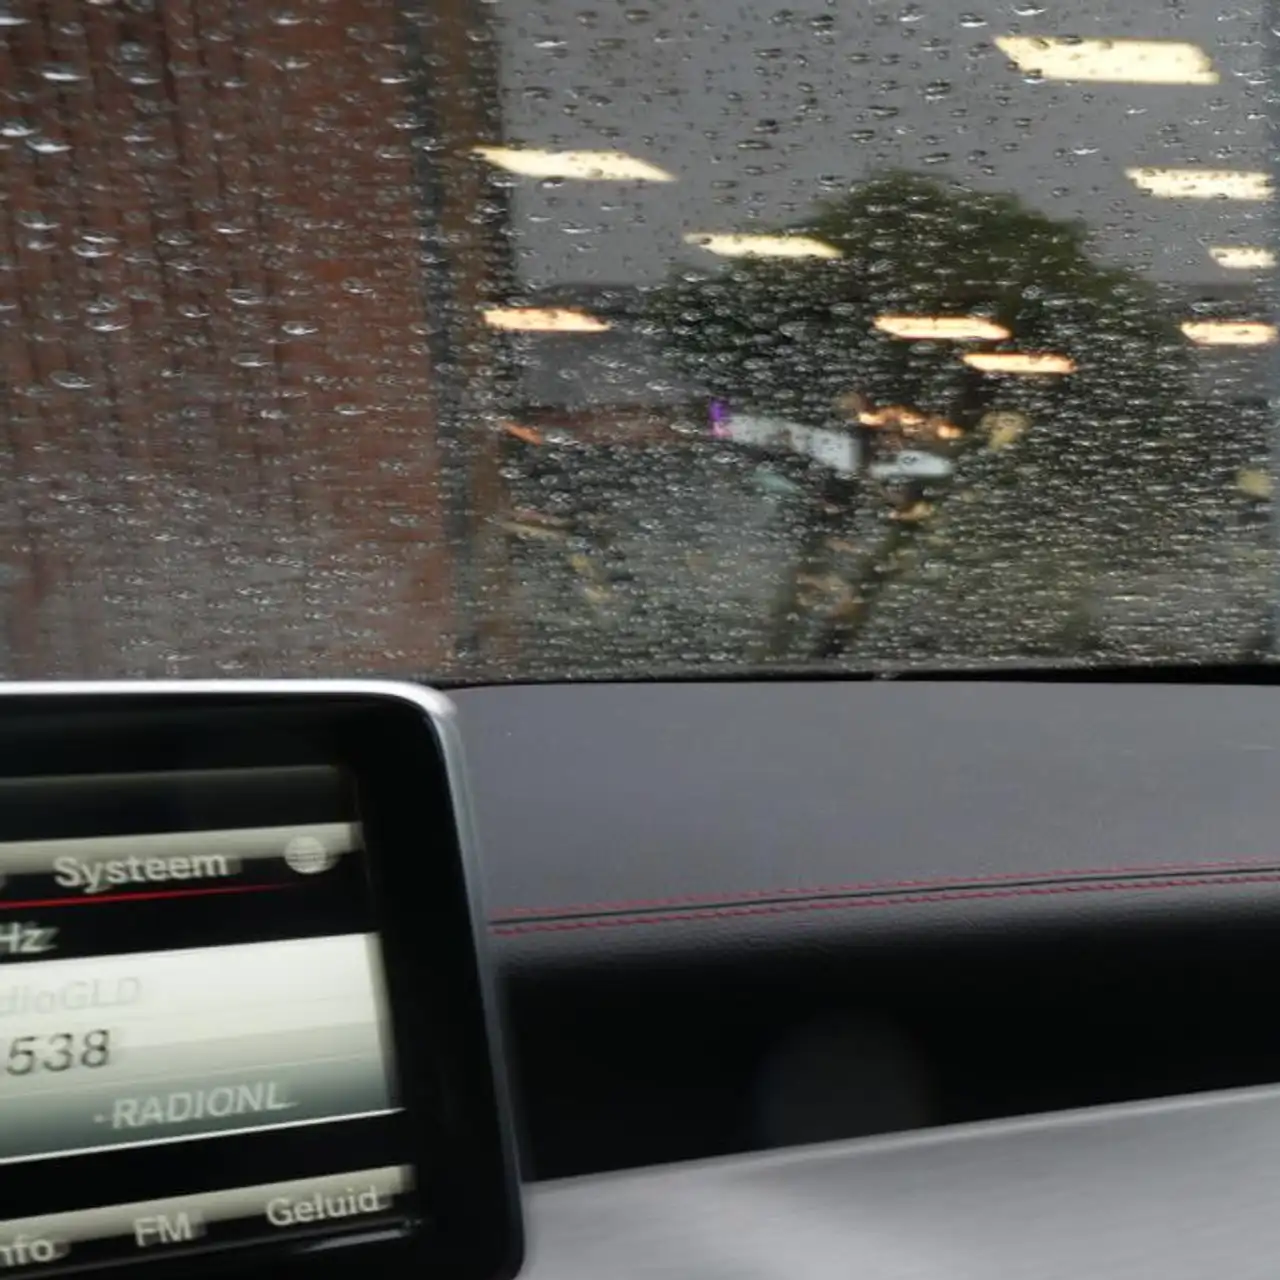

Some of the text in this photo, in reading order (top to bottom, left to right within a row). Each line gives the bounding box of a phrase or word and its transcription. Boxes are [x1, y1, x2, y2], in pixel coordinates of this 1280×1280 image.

[54, 854, 229, 894] Systeem
[5, 1029, 110, 1077] 538
[266, 1185, 382, 1227] Geluid
[134, 1212, 194, 1248] FM
